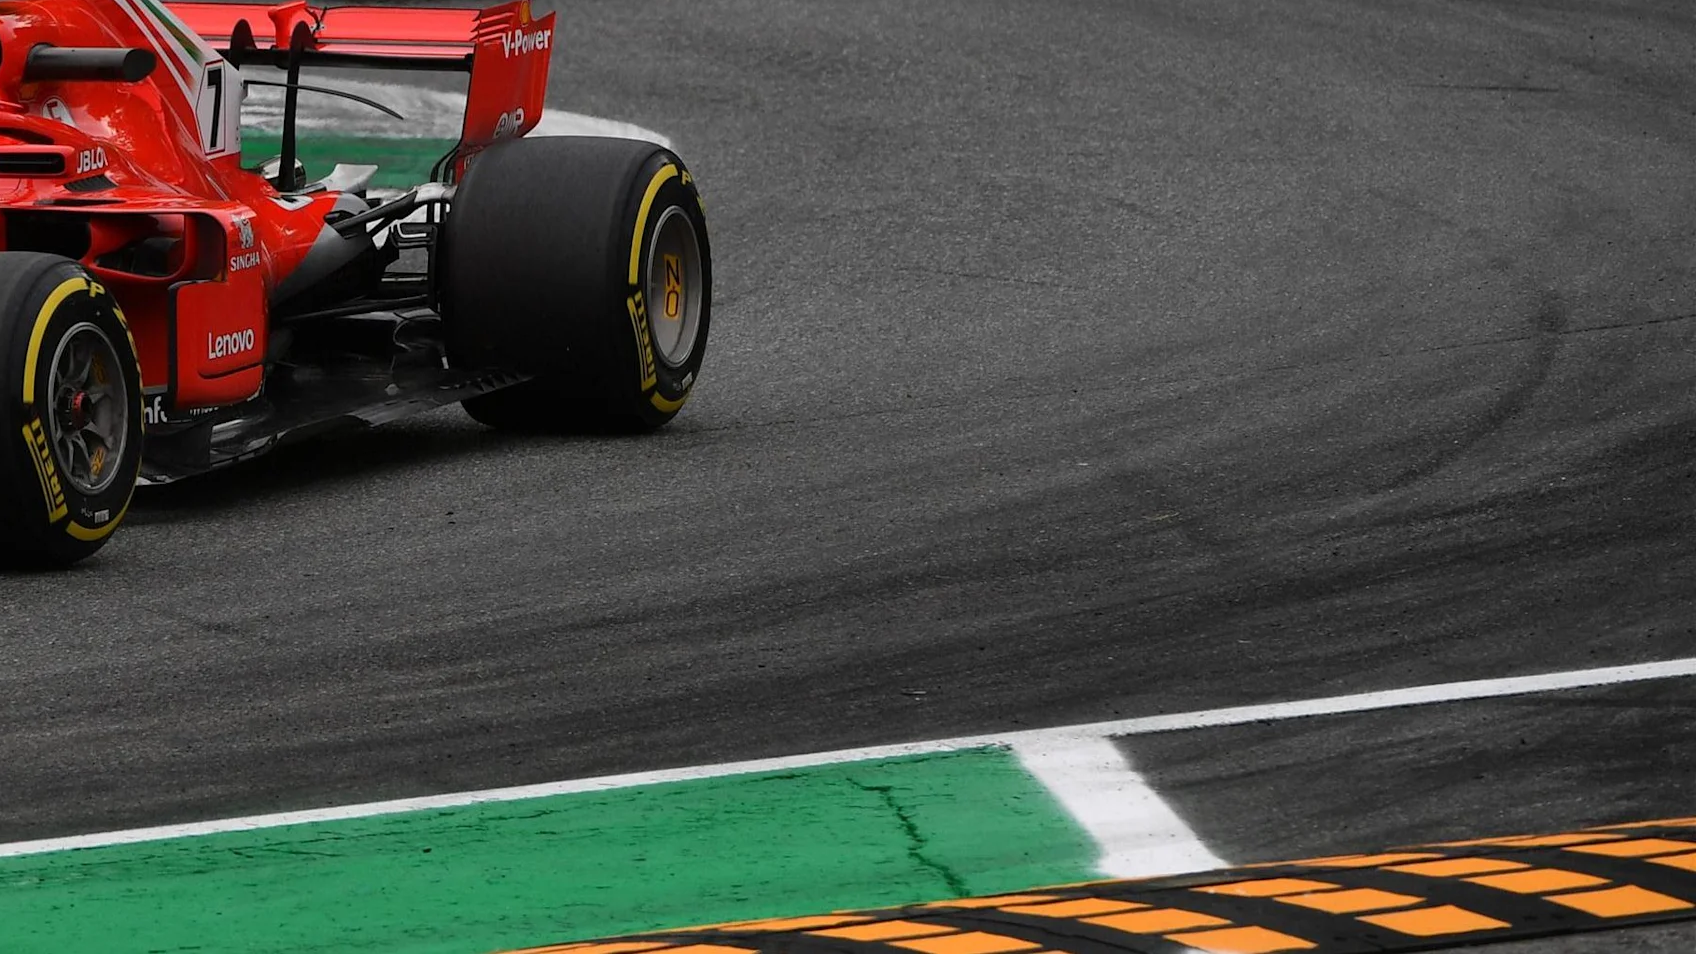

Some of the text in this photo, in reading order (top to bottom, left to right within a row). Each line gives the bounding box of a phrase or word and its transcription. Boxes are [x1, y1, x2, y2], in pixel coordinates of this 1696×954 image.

[502, 29, 551, 59] V-Power
[206, 66, 222, 151] 7
[230, 251, 260, 272] SINGHA
[208, 328, 255, 359] Lenovo
